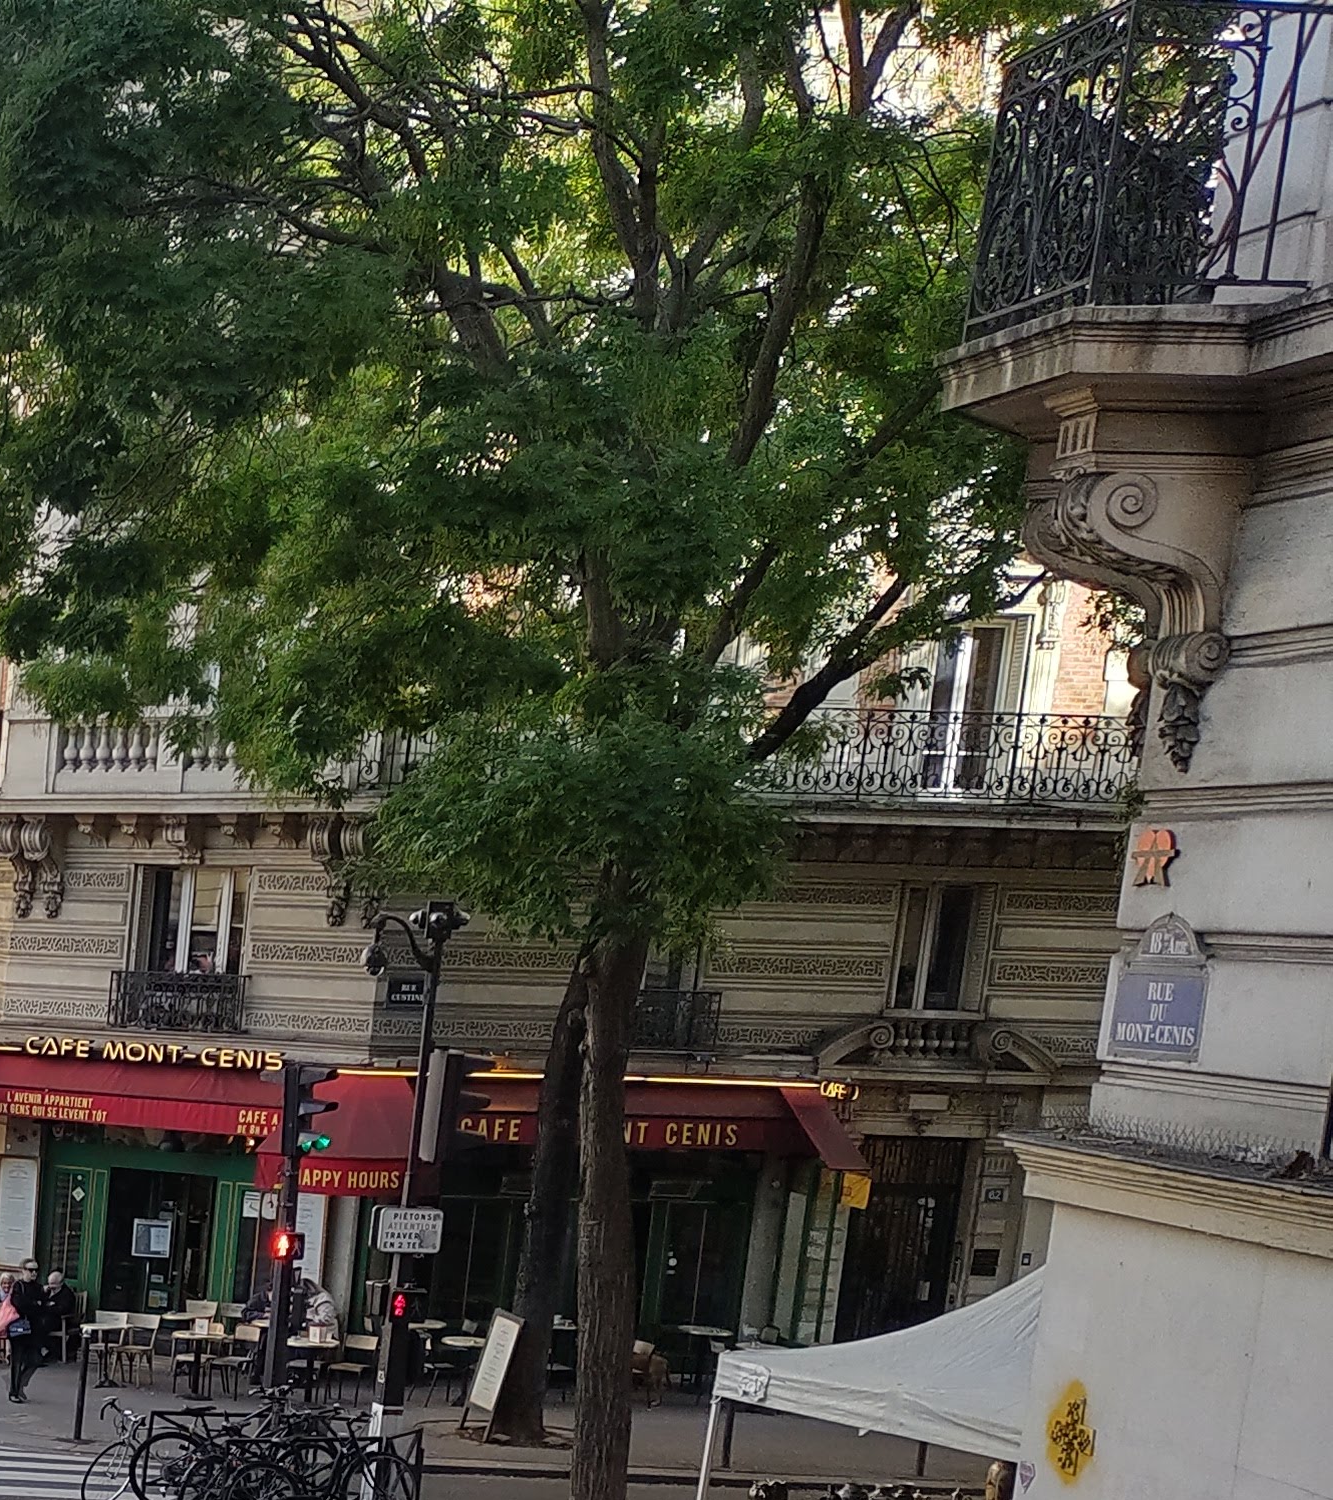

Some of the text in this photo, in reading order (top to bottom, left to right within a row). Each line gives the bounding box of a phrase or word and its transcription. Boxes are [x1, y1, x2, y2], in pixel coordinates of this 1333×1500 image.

[1147, 982, 1174, 1001] RUE
[1149, 1003, 1167, 1022] DU
[1116, 1022, 1195, 1046] MONT-CENIS
[26, 1036, 90, 1058] CAFE
[7, 1091, 93, 1109] L'AVENIR APPARTIENT
[10, 1104, 30, 1115] GENS
[32, 1105, 45, 1117] QUI
[47, 1107, 56, 1118] SE
[59, 1107, 89, 1121] LEVENT
[239, 1110, 268, 1125] CAFE
[461, 1118, 522, 1141] CAFE
[665, 1123, 738, 1146] CENIS
[347, 1170, 400, 1189] HOURS
[393, 1212, 432, 1221] PIÉTONS
[388, 1222, 437, 1230] ATTENTION
[383, 1241, 395, 1249] EN
